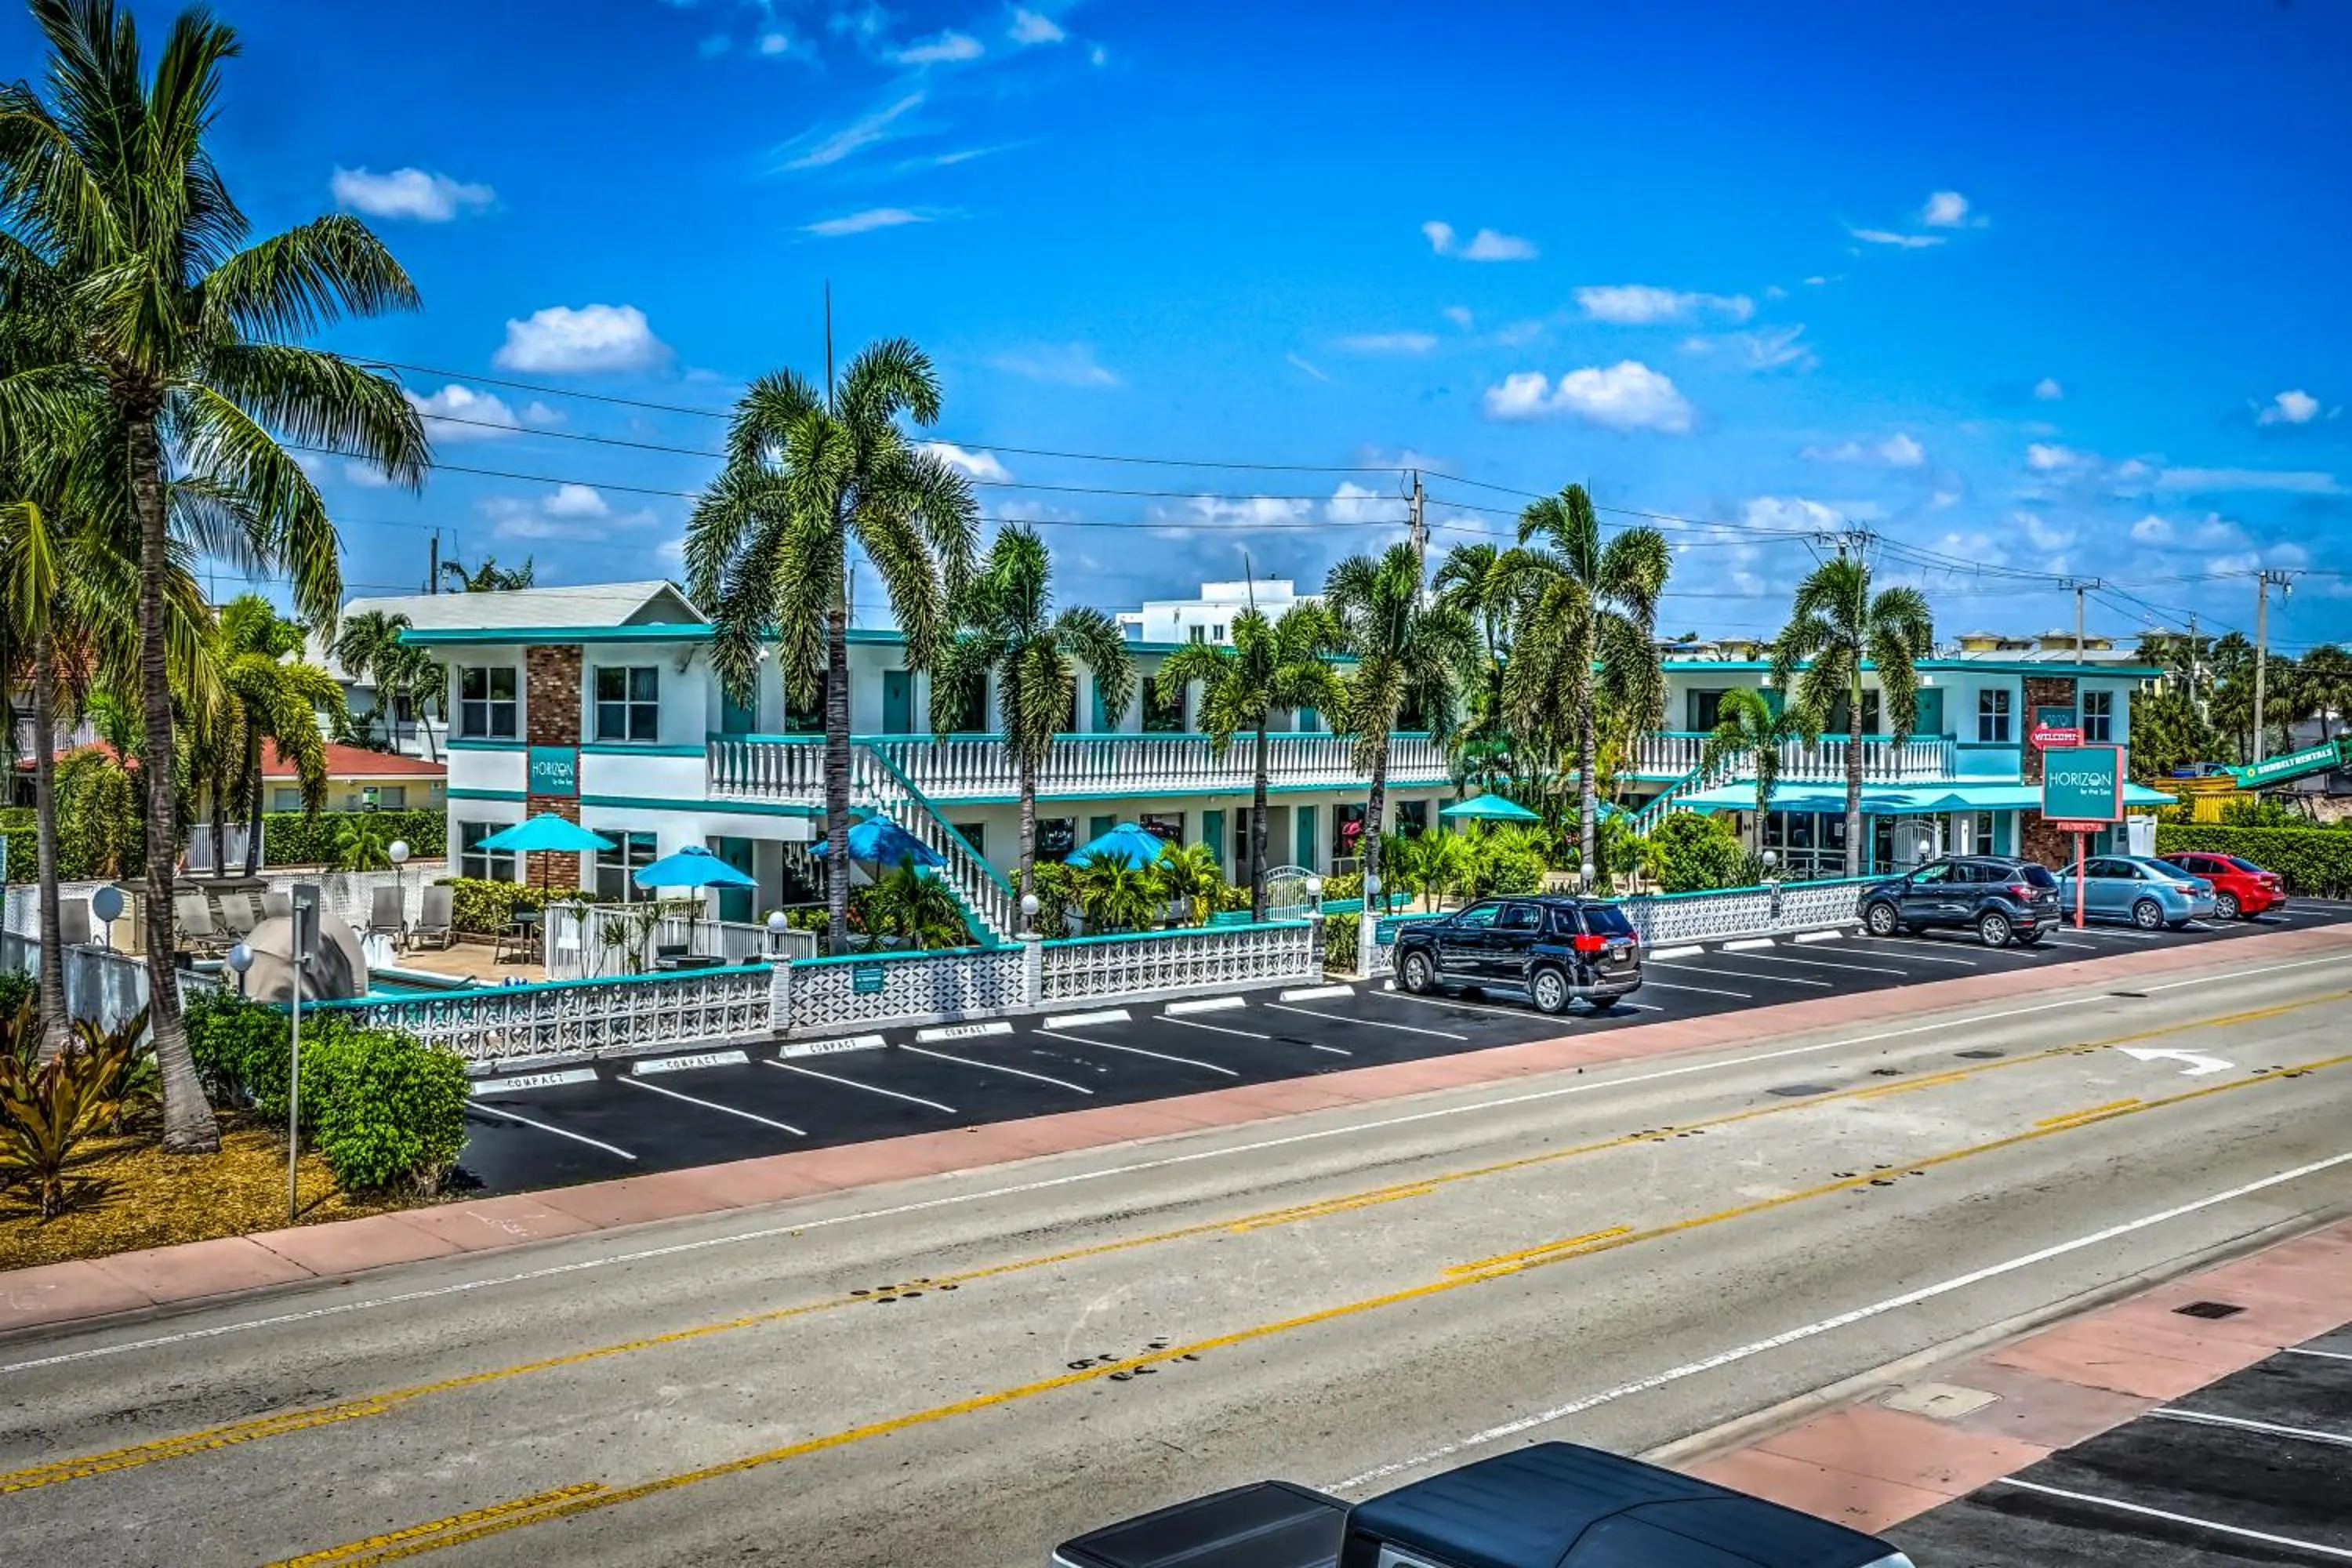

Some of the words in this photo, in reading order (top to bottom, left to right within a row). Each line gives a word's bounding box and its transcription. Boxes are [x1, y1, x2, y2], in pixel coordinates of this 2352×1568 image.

[532, 761, 573, 778] HORIZON
[2049, 771, 2111, 788] HORIZON
[666, 1054, 717, 1069] COMPACT
[507, 1073, 564, 1087] COMPACT
